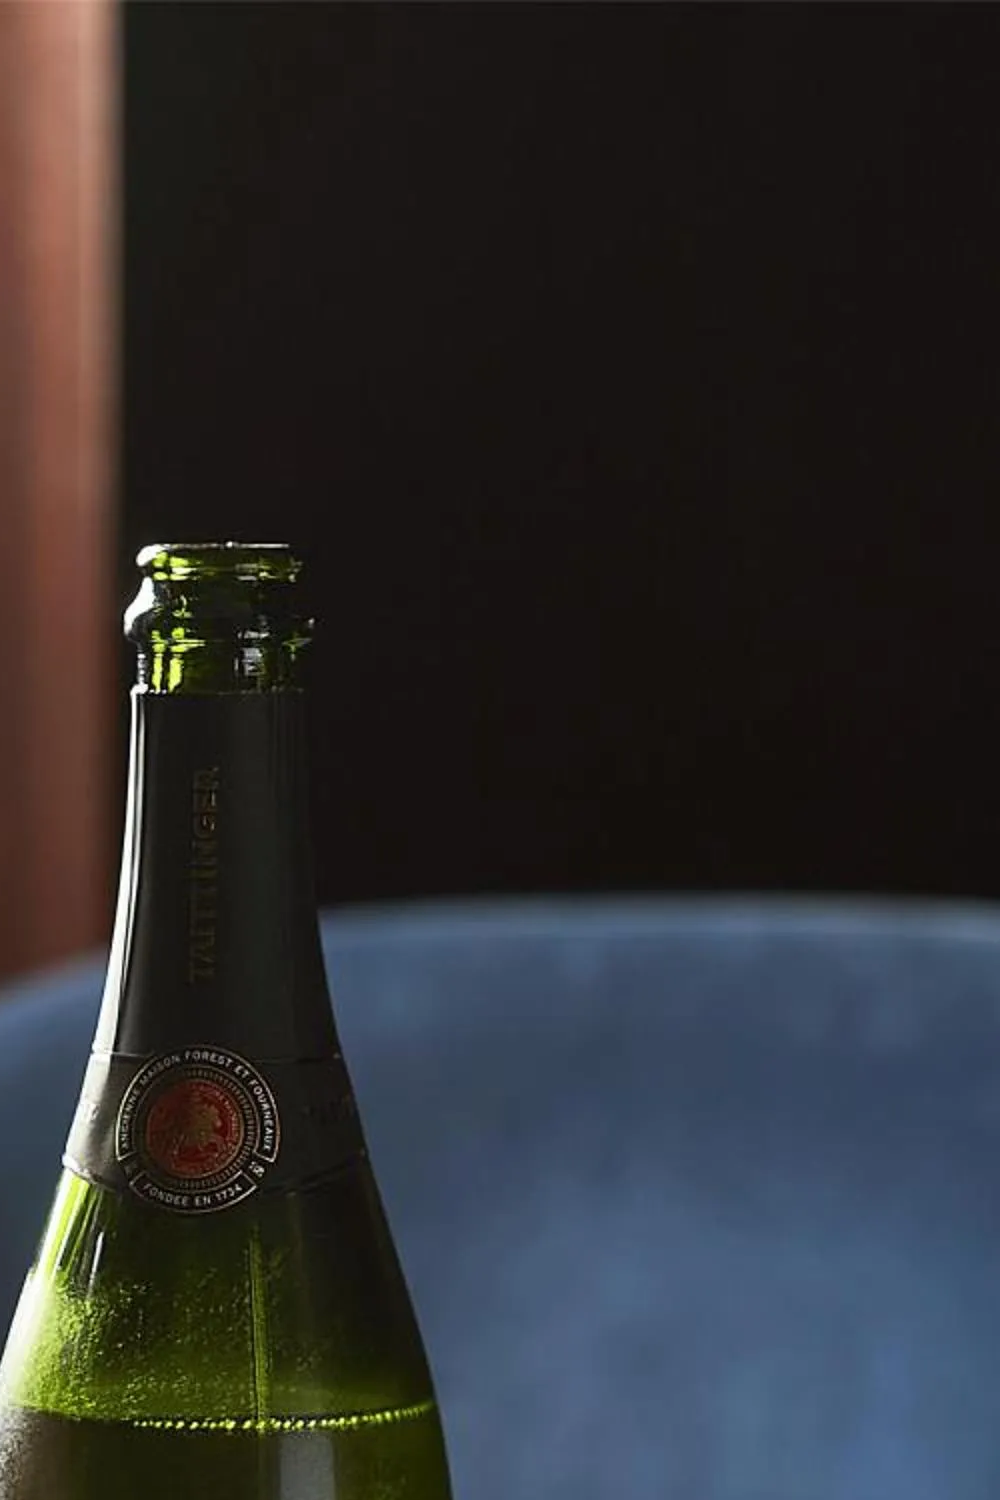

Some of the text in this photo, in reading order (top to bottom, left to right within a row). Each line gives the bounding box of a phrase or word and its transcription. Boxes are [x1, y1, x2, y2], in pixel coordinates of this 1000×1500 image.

[184, 1050, 233, 1068] FOREST
[234, 1063, 250, 1080] ET
[194, 1193, 212, 1207] EN
